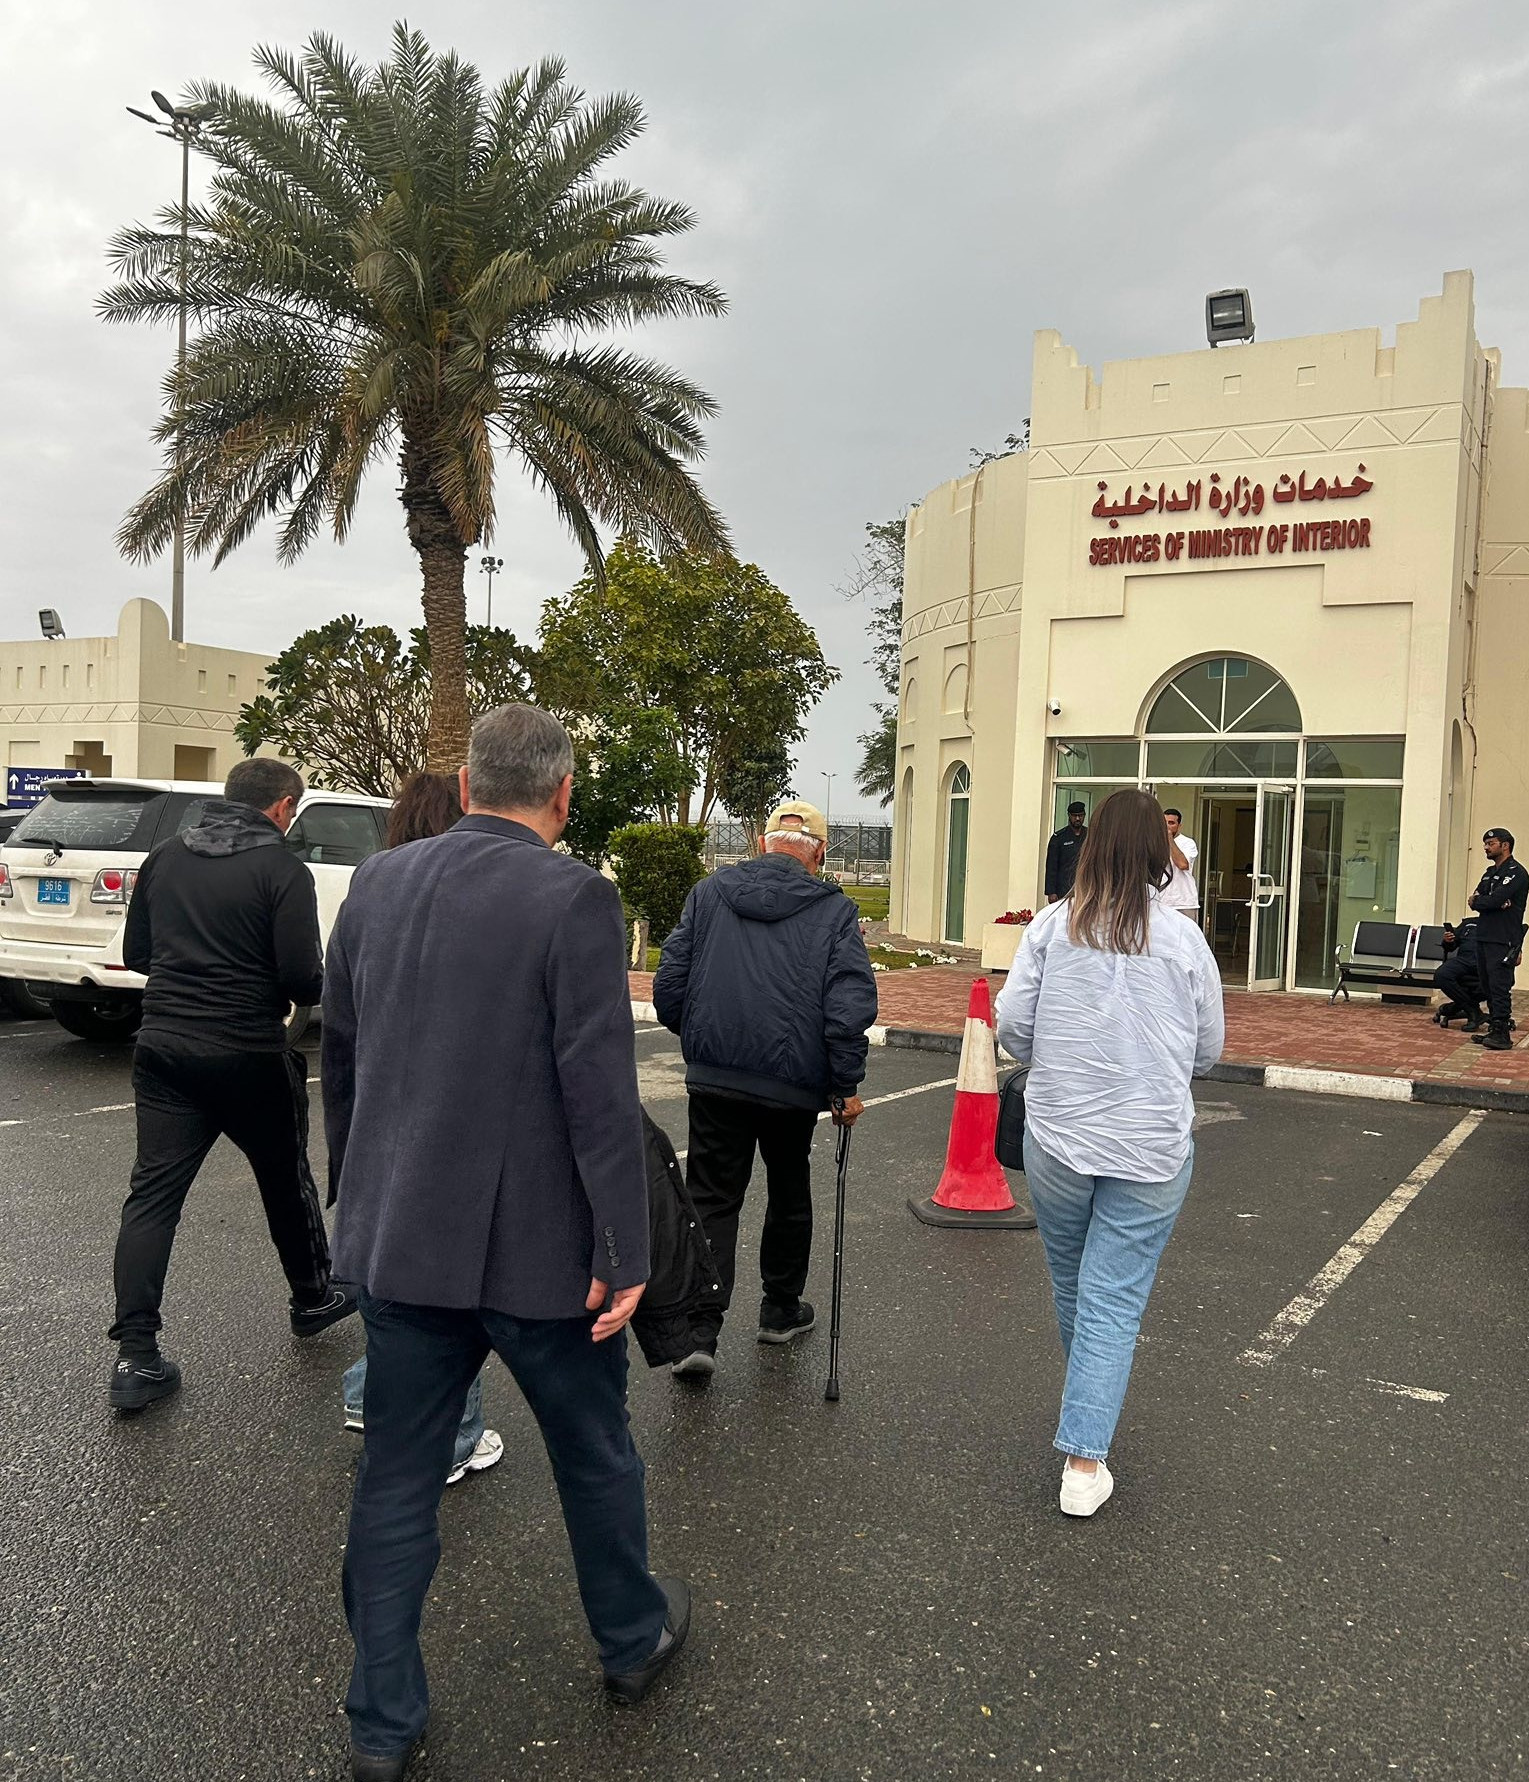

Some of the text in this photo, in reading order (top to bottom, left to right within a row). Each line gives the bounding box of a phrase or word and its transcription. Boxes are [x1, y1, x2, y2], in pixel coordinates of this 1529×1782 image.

[1091, 462, 1374, 529] خدمات وزارة الداخلية
[1089, 518, 1371, 566] SERVICES OF MINISTRY OF INTERIOR
[45, 880, 62, 891] 9616
